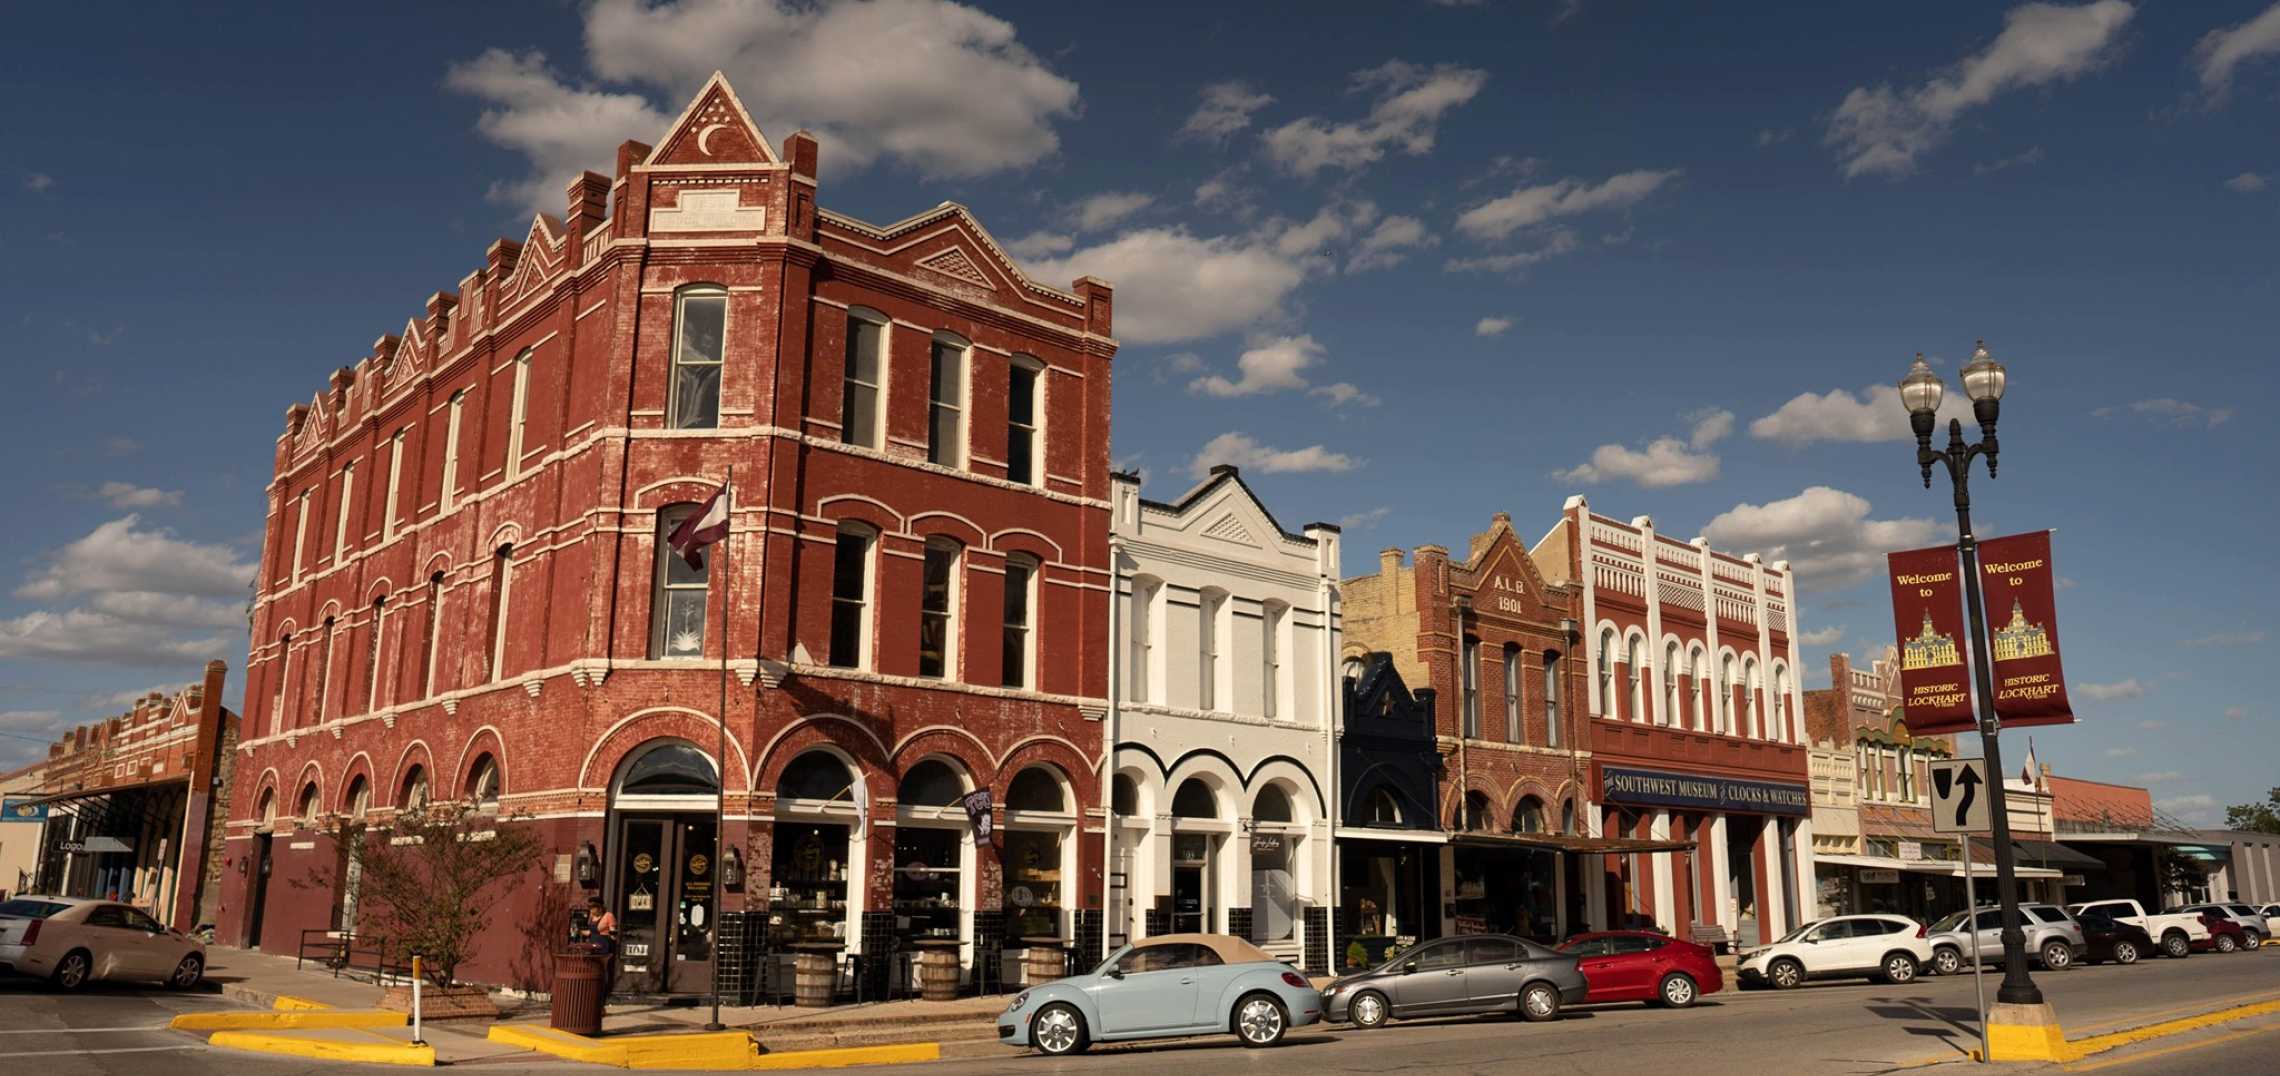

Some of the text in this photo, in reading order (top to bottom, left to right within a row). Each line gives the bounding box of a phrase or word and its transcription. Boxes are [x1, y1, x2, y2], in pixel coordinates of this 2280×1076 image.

[1985, 559, 2043, 574] Welcome
[1897, 571, 1952, 585] Welcome
[2009, 576, 2023, 586] to
[1920, 588, 1933, 597] to
[1499, 596, 1522, 614] 1901
[2004, 673, 2050, 687] HISTORIC
[1913, 683, 1959, 695] HISTORIC
[1999, 683, 2060, 700] LOCKHART
[1908, 692, 1967, 707] LOCKHART
[1615, 775, 1677, 796] SOUTHWEST
[1679, 780, 1718, 799] MUSEUM
[1728, 785, 1761, 803] CLOCKS
[1770, 790, 1807, 806] WATCHES
